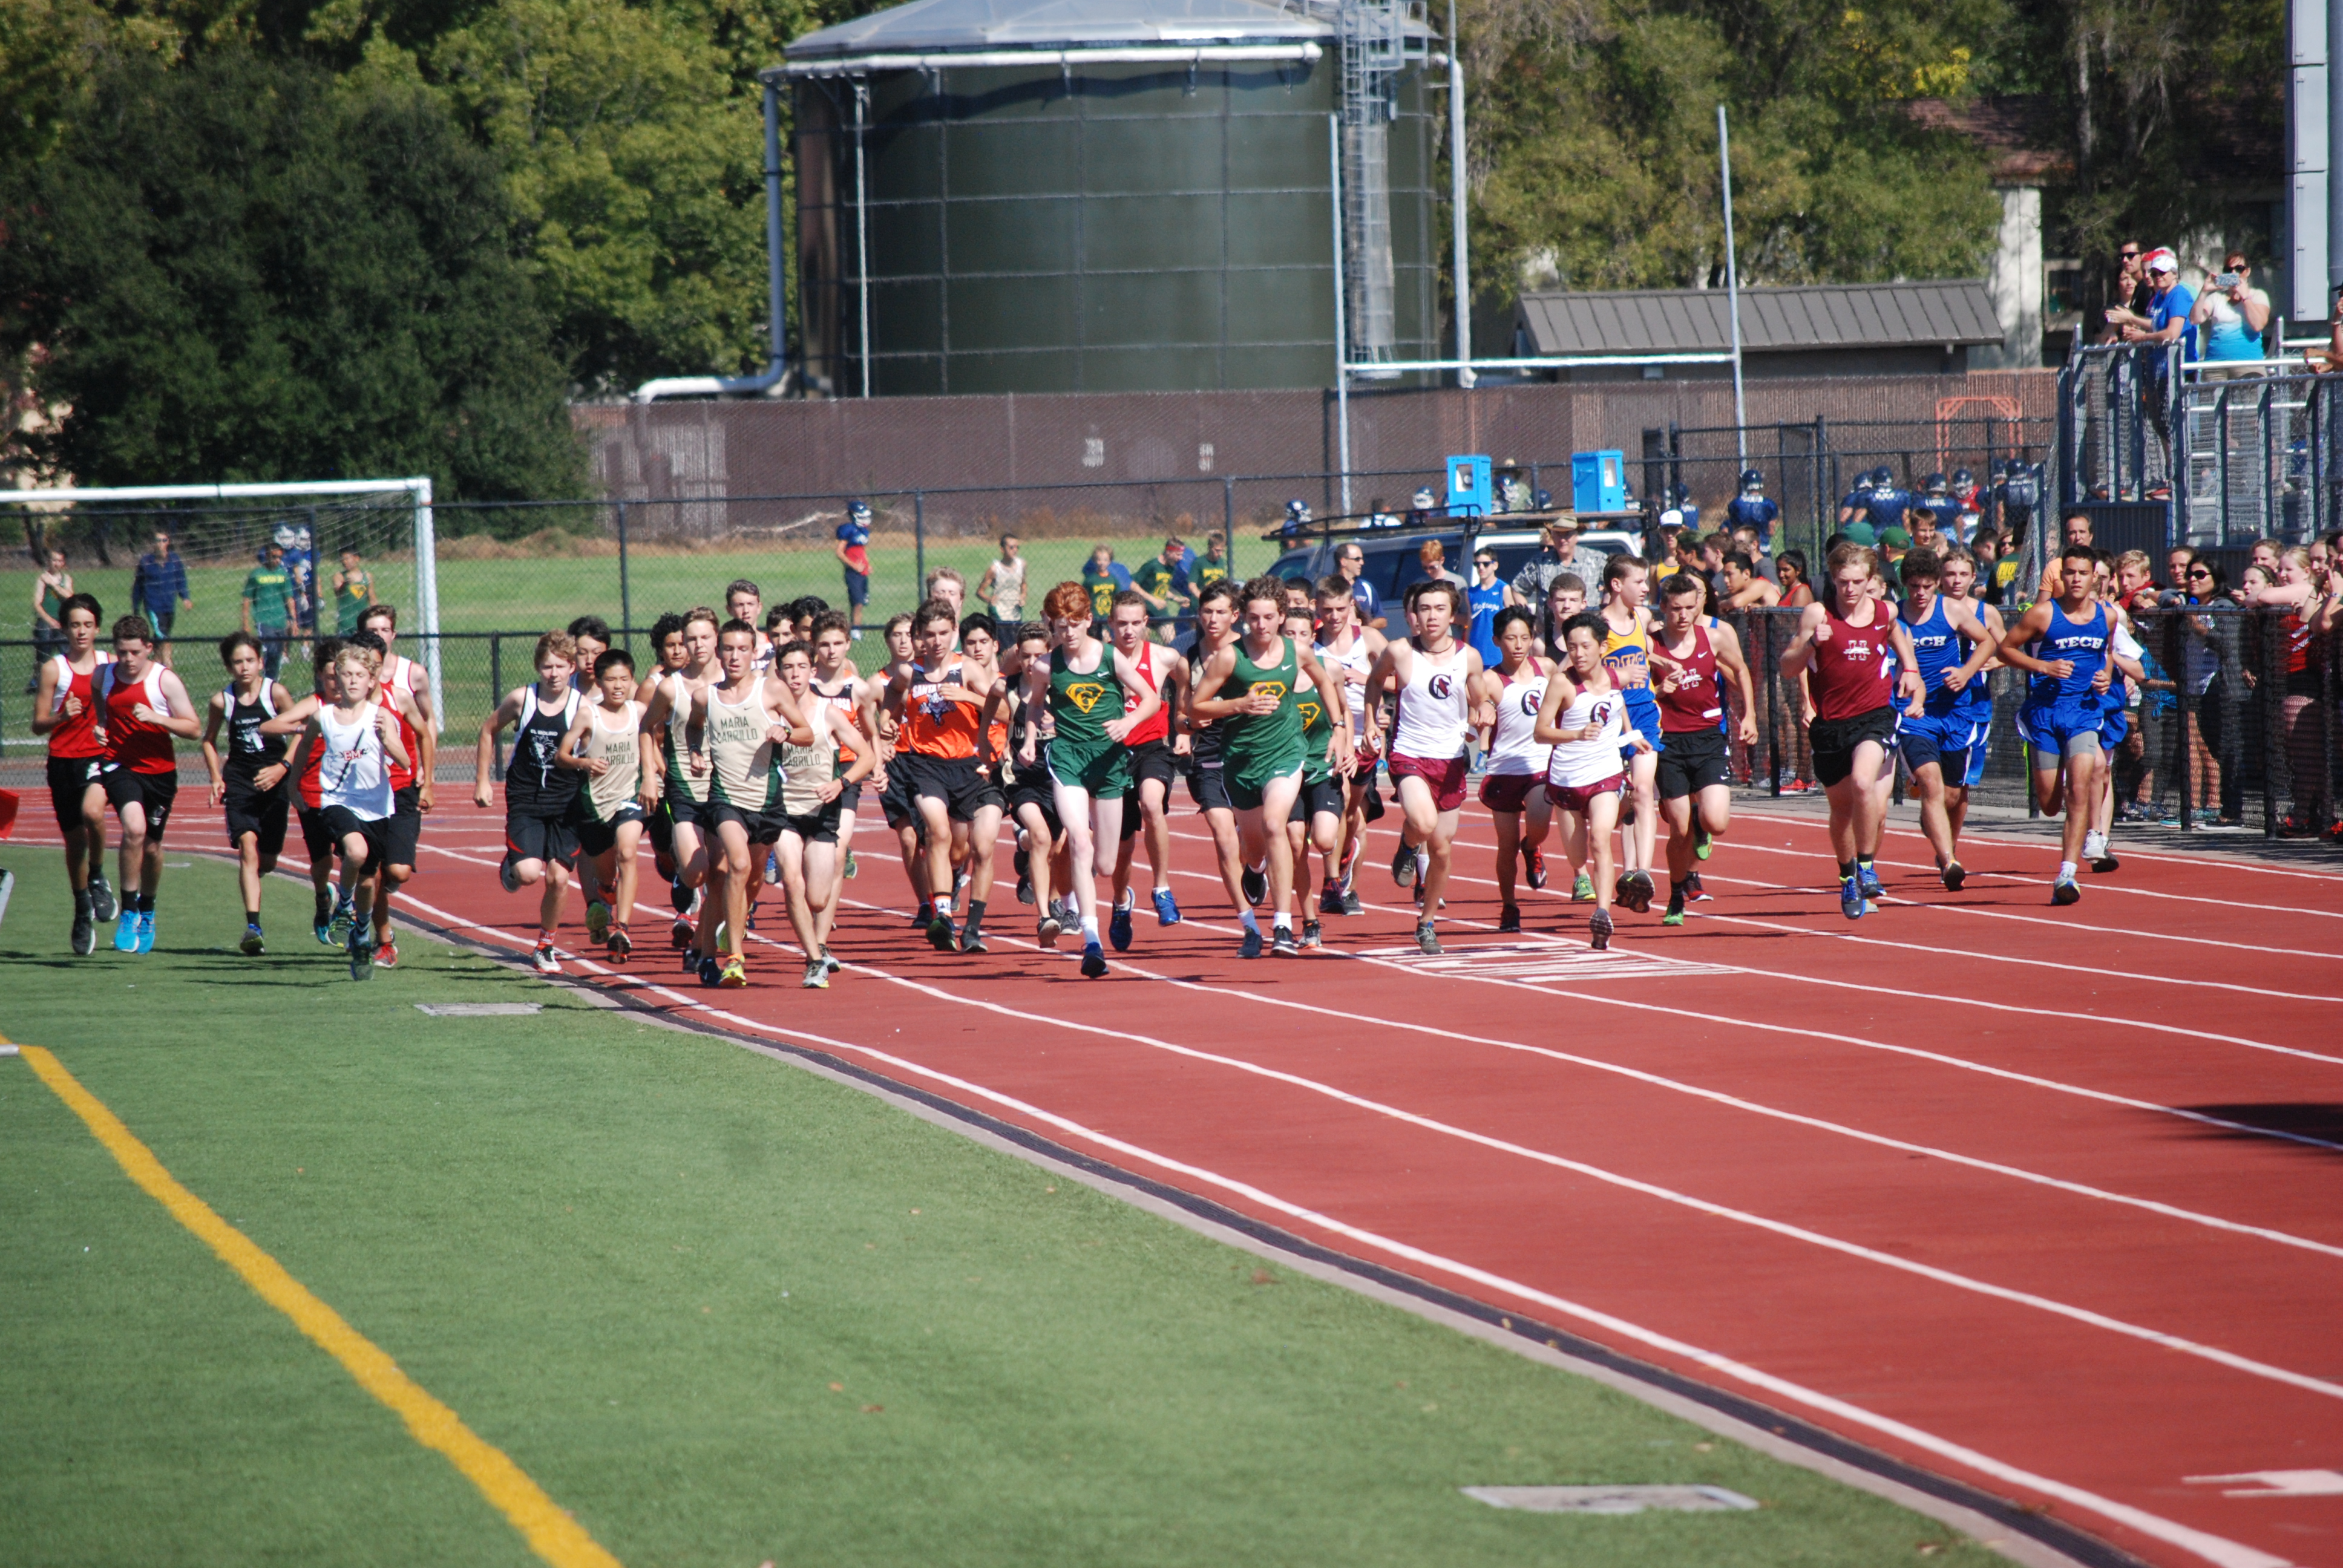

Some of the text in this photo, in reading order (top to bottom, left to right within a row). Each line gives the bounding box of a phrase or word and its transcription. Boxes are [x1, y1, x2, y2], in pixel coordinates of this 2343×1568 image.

[1913, 636, 1947, 647] ECH
[2055, 636, 2104, 649] TECH
[913, 684, 937, 698] SANTA
[720, 716, 749, 730] MARIA
[717, 728, 758, 743] CARRILLO
[606, 741, 631, 754] MARIA
[787, 745, 813, 755] MARIA
[343, 750, 362, 761] EM
